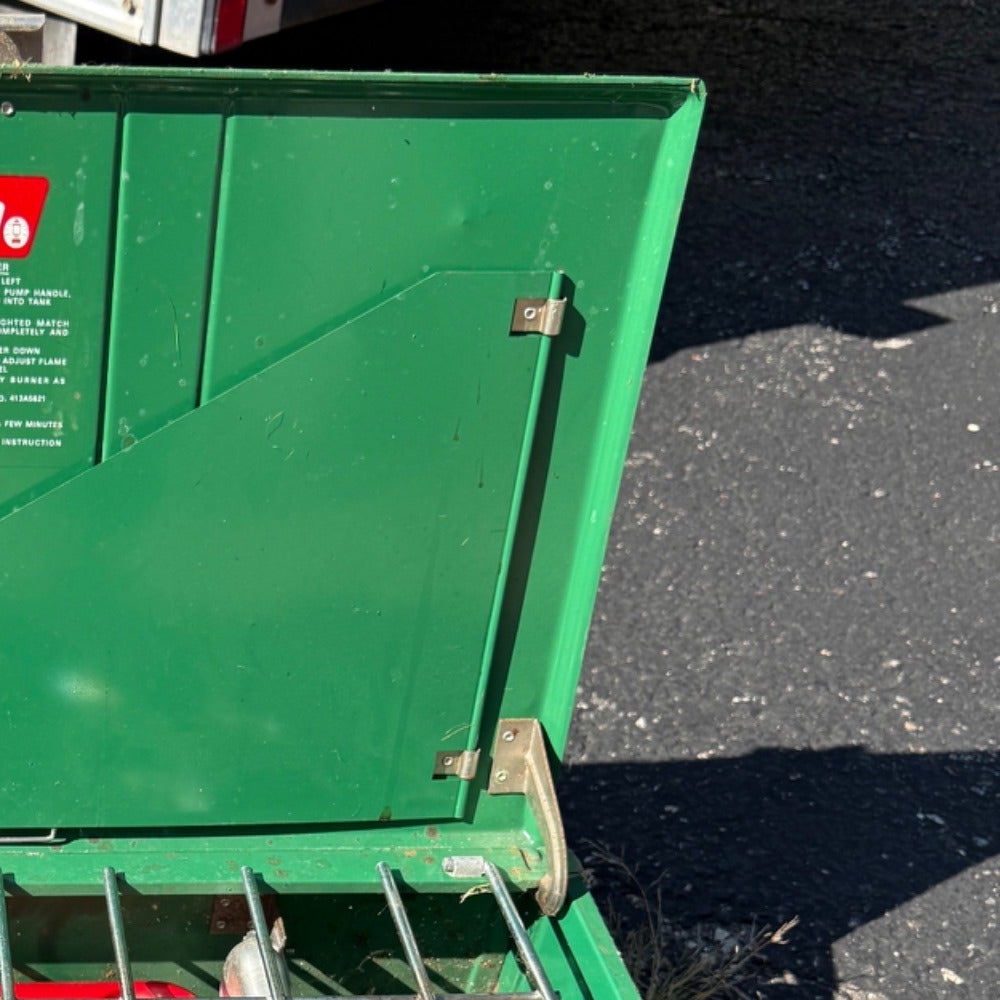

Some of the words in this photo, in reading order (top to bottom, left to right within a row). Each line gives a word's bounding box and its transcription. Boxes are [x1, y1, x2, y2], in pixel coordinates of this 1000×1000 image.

[1, 276, 21, 286] LEFT
[4, 288, 30, 297] PUMP
[3, 297, 24, 306] INTO
[28, 297, 51, 306] TANK
[36, 319, 69, 328] MATCH
[49, 328, 69, 336] AND
[12, 346, 40, 355] DOWN
[2, 356, 36, 366] ADJUST
[38, 357, 66, 366] FLAME
[10, 376, 50, 385] BURNER
[53, 377, 66, 385] AS
[4, 420, 22, 428] FEW
[25, 419, 63, 429] MINUTES
[2, 438, 62, 447] INSTRUCTION
